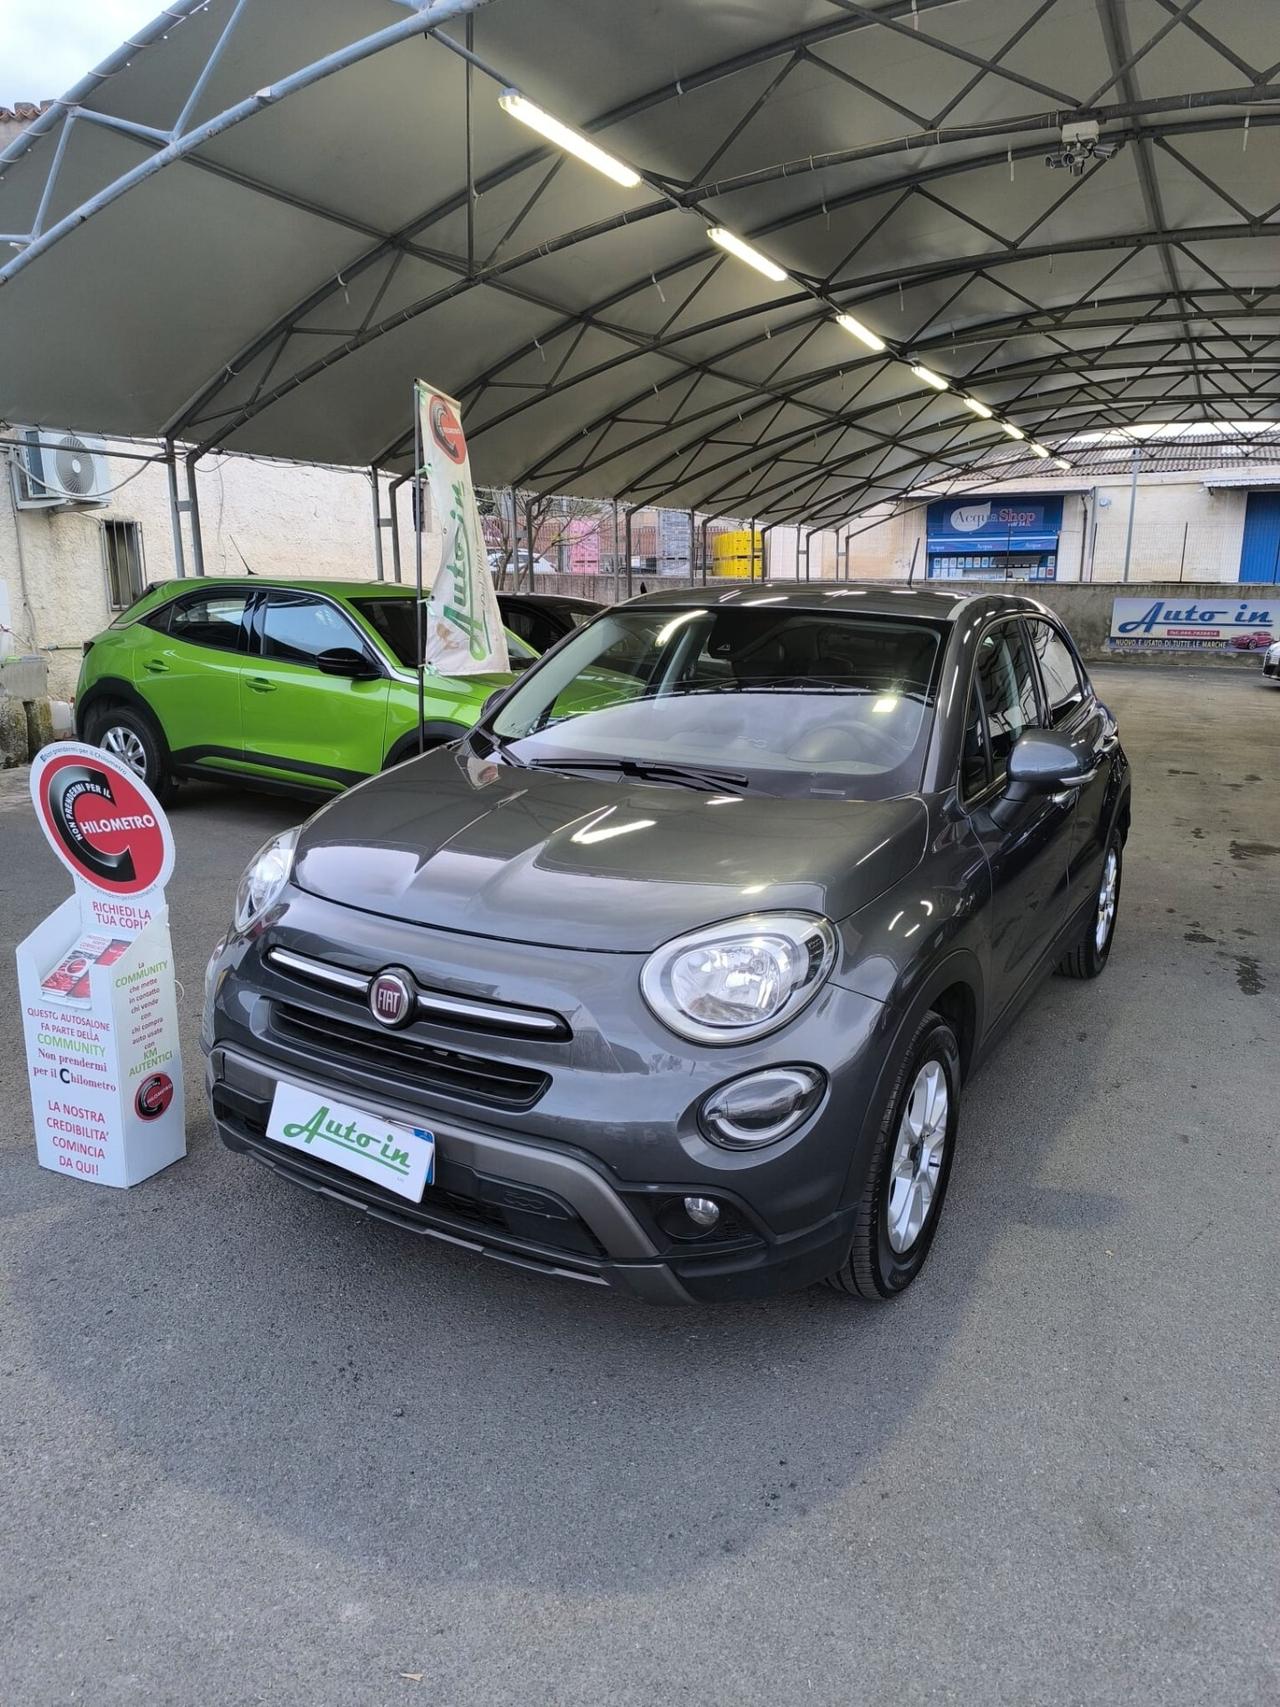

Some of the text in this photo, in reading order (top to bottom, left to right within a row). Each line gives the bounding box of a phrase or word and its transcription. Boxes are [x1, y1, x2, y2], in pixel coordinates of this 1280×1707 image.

[999, 508, 1036, 524] Shop
[1118, 602, 1273, 633] Auto in
[1116, 639, 1136, 647] NUOVO
[1144, 640, 1163, 648] USATO
[1164, 640, 1172, 648] DI
[1173, 640, 1191, 648] TUTTE
[1192, 640, 1201, 648] LE
[1202, 640, 1227, 649] MARCHE
[65, 783, 112, 841] NON PRENDERMI PER IL
[92, 901, 152, 920] RICHIEDI LA
[96, 912, 118, 926] TUA
[115, 960, 168, 988] COMMUNITY
[377, 988, 400, 1013] FIAT
[41, 1022, 100, 1042] FA PARTE DELLA
[60, 1013, 111, 1031] AUTOSALONE
[37, 1033, 106, 1058] COMMUNITY
[132, 1034, 146, 1045] auto
[38, 1047, 107, 1073] Non prendermi
[129, 1050, 173, 1077] AUTENTICI
[143, 1047, 158, 1060] KM
[33, 1066, 117, 1092] per il Chilometro
[48, 1099, 106, 1124] LA NOSTRA
[46, 1117, 109, 1142] CREDIBILITA'
[283, 1106, 411, 1168] Auto in
[52, 1136, 106, 1159] COMINCIA
[58, 1155, 99, 1176] DA QUI!
